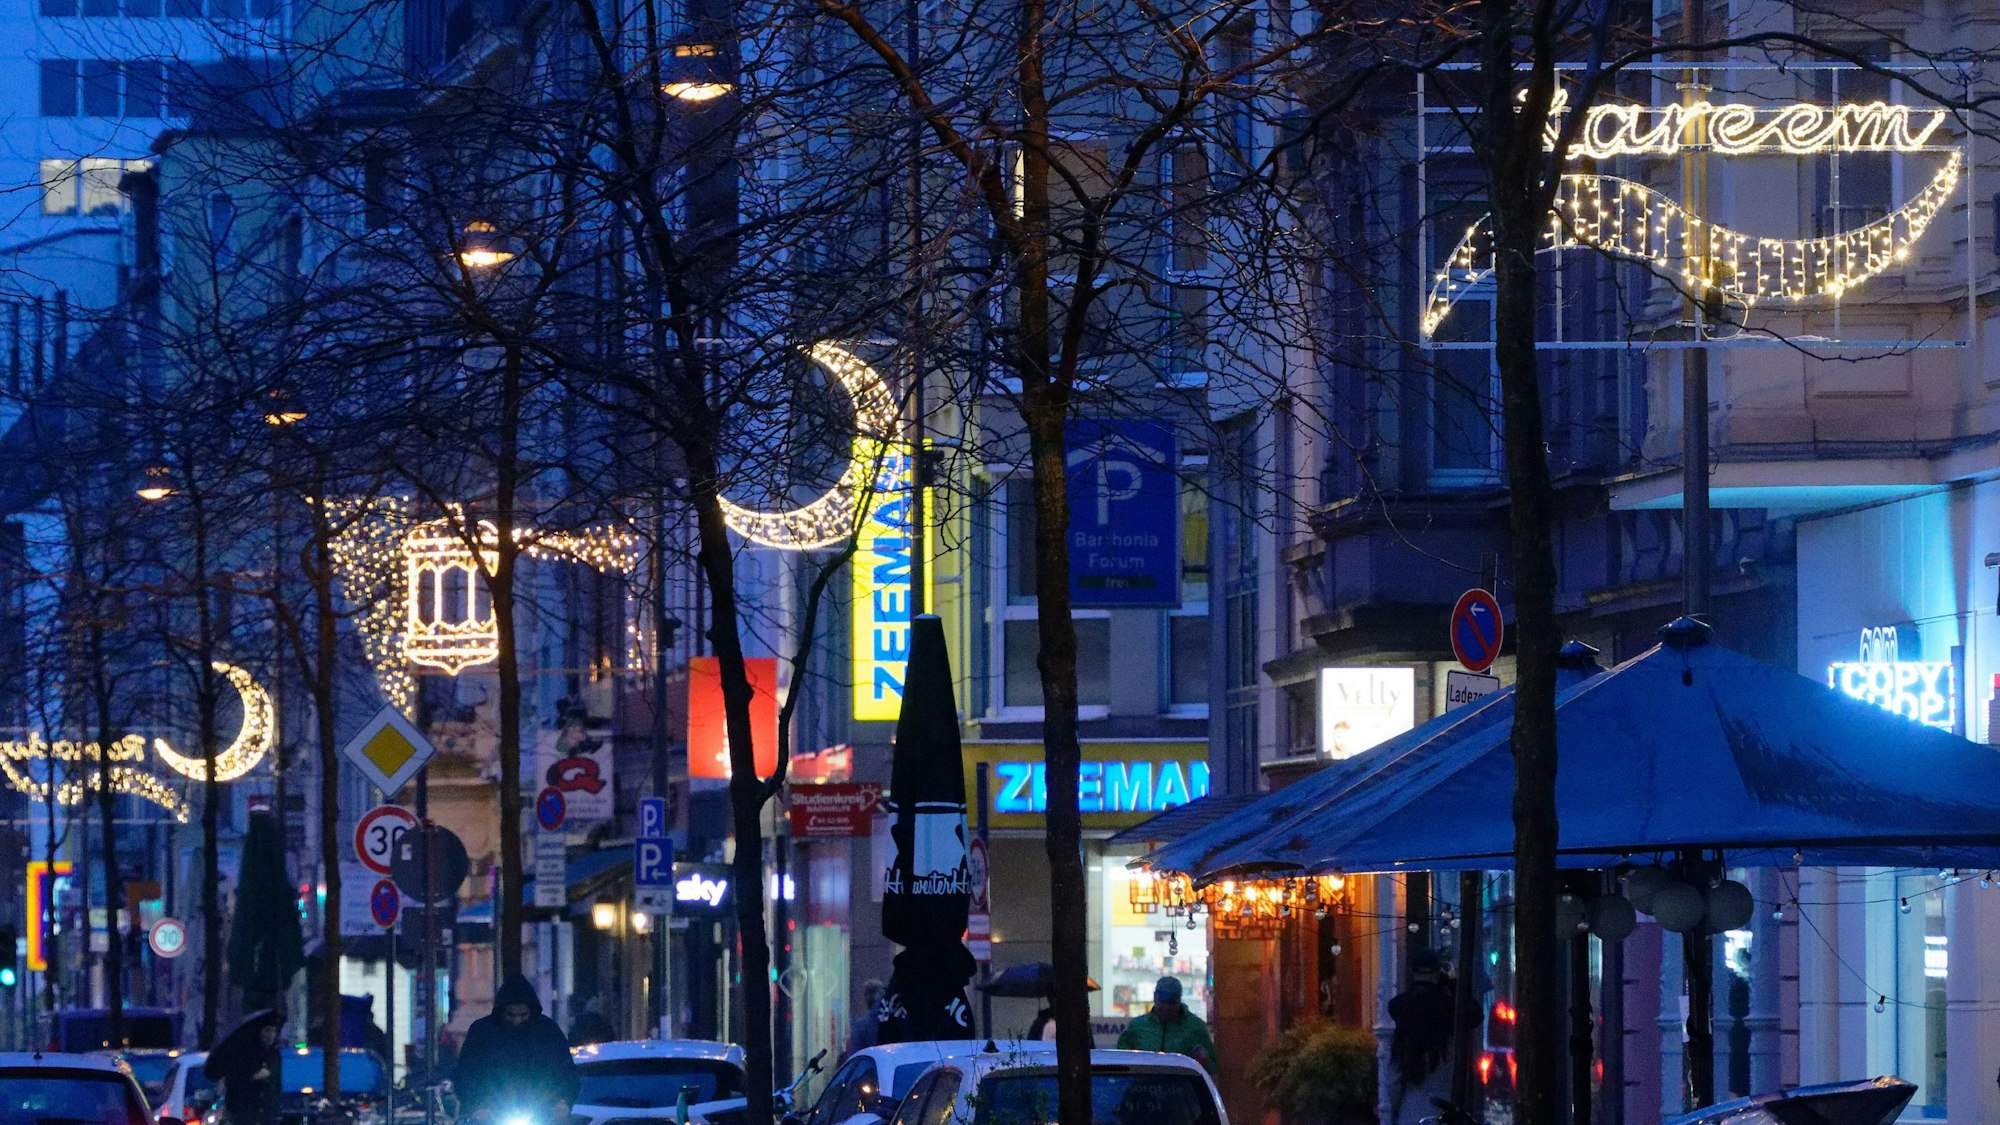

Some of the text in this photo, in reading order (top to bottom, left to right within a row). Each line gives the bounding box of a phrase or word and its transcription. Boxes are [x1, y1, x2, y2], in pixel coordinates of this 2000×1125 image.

[1098, 461, 1143, 525] P
[1449, 684, 1489, 703] Ladez
[1842, 663, 1943, 701] COPY
[643, 804, 657, 838] P
[640, 843, 662, 881] P
[676, 873, 727, 906] sky
[158, 929, 178, 947] 30
